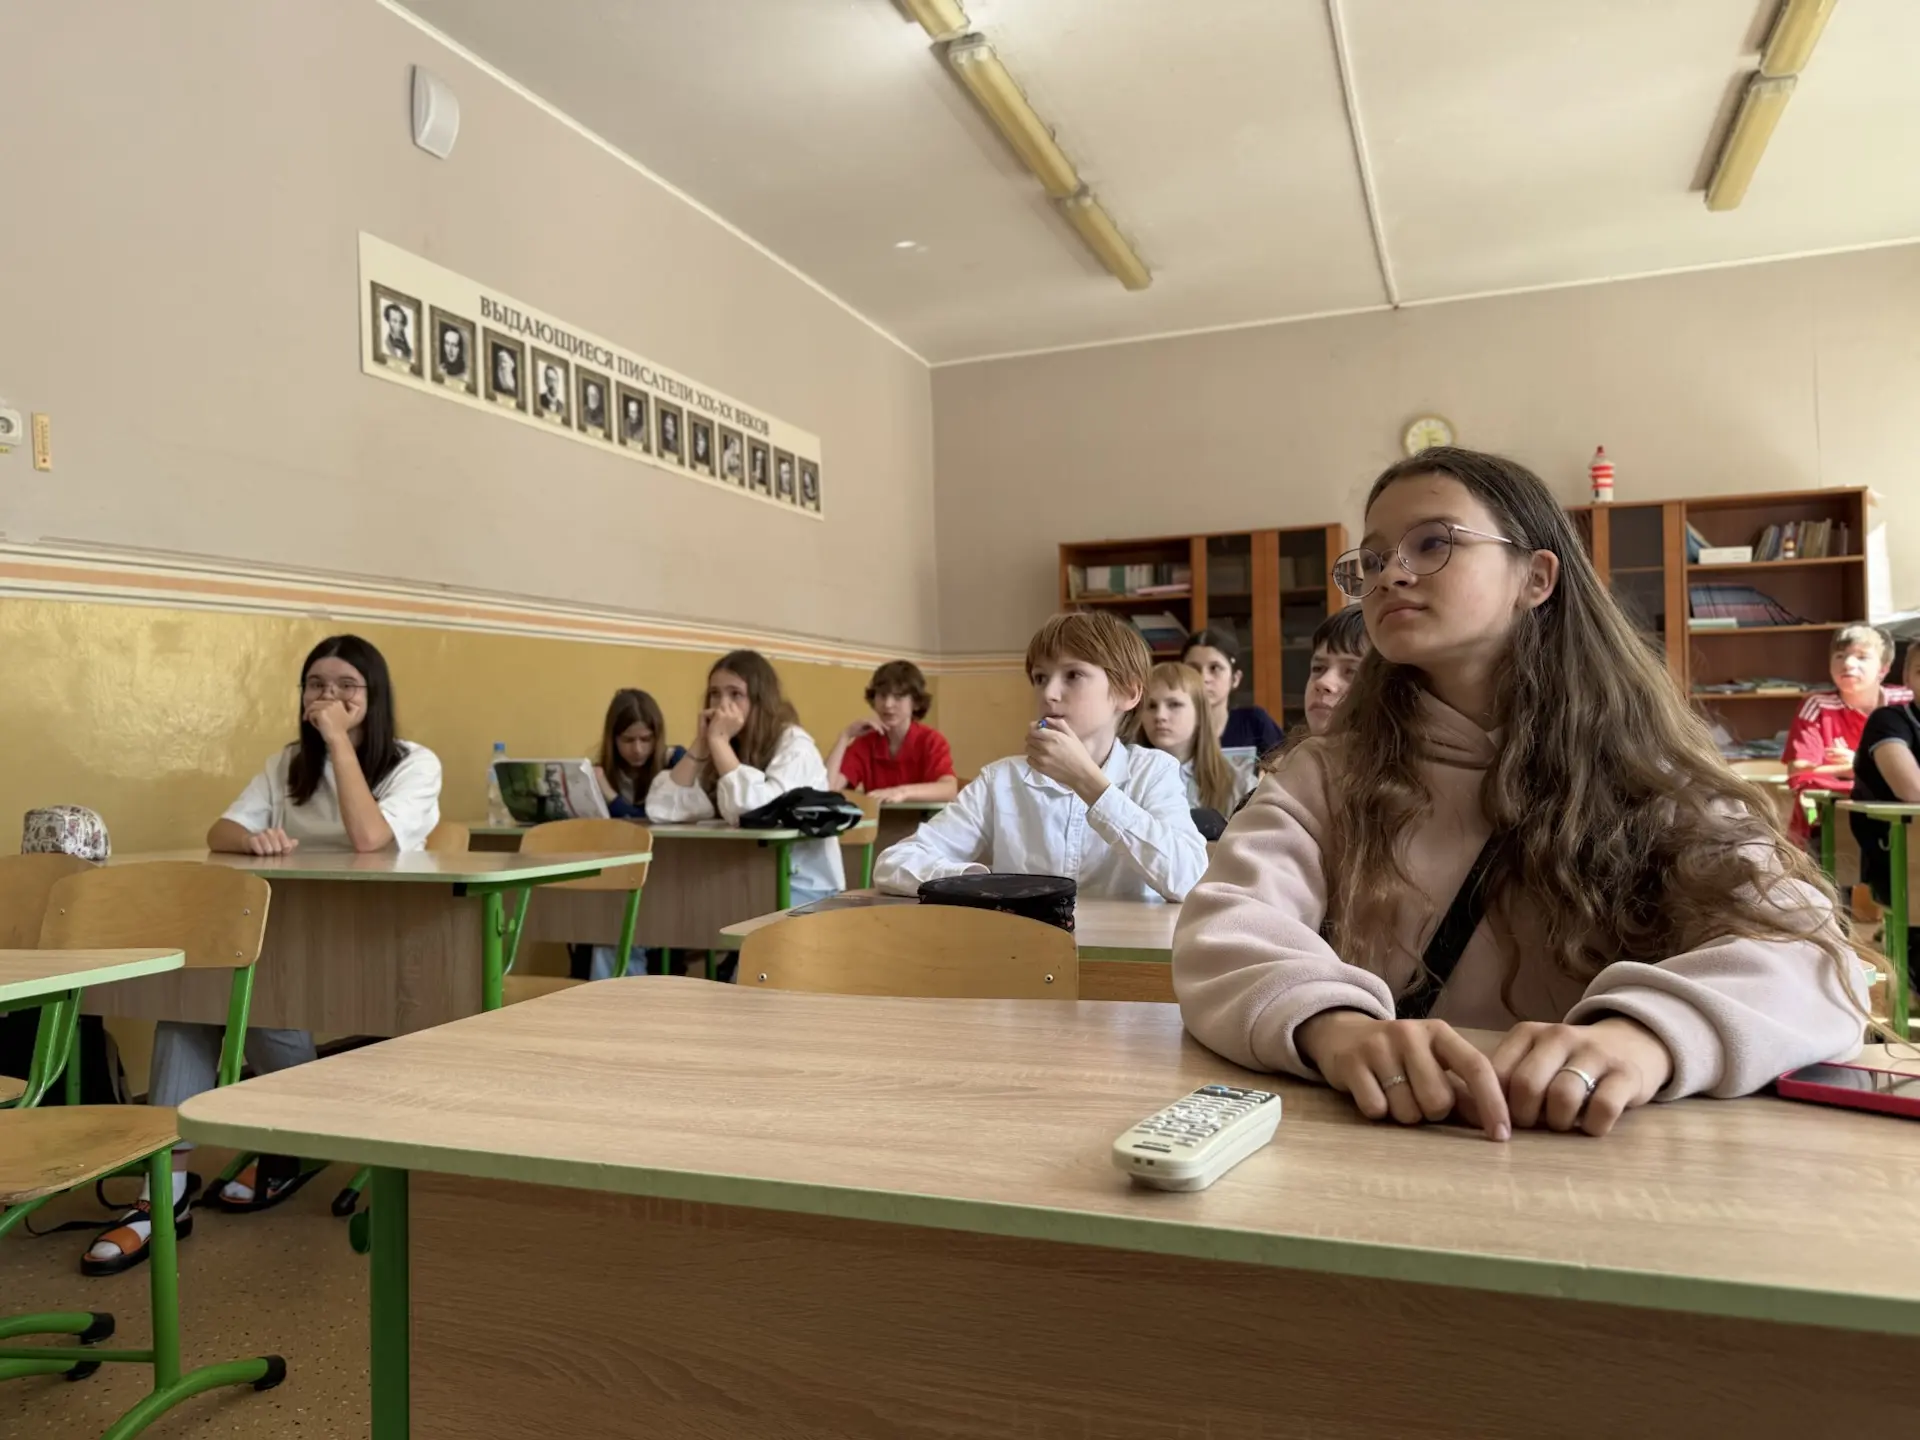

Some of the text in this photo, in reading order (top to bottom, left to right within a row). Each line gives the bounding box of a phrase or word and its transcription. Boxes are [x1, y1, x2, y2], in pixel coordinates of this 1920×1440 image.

[480, 295, 614, 371] ВЫДАЮЩИЕСЯ
[617, 356, 694, 405] ПИСАТЕЛИ
[735, 408, 770, 436] ВЕКОВ
